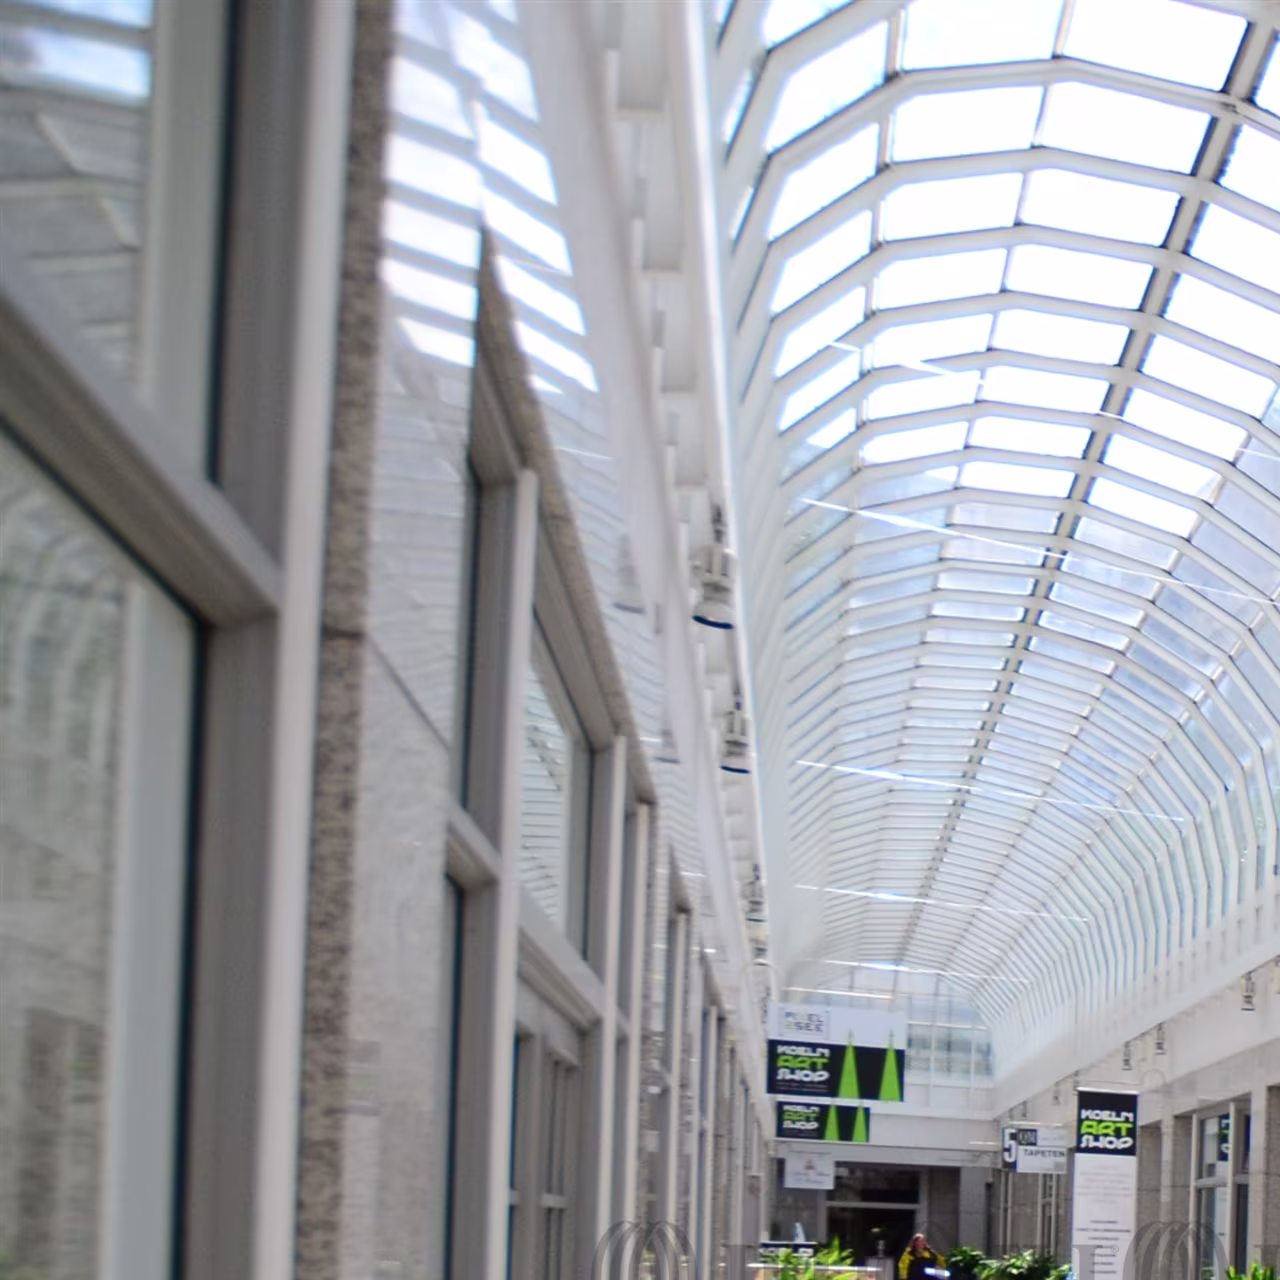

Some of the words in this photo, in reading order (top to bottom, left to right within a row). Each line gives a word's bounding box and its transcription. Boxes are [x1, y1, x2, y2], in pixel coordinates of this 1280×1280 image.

[776, 1055, 829, 1070] ART
[776, 1067, 830, 1082] SHOP
[1080, 1109, 1134, 1122] KOELN
[1080, 1120, 1133, 1136] ART
[1003, 1128, 1017, 1163] 5
[1080, 1134, 1134, 1150] SHOP
[1023, 1148, 1065, 1158] TAPETEN
